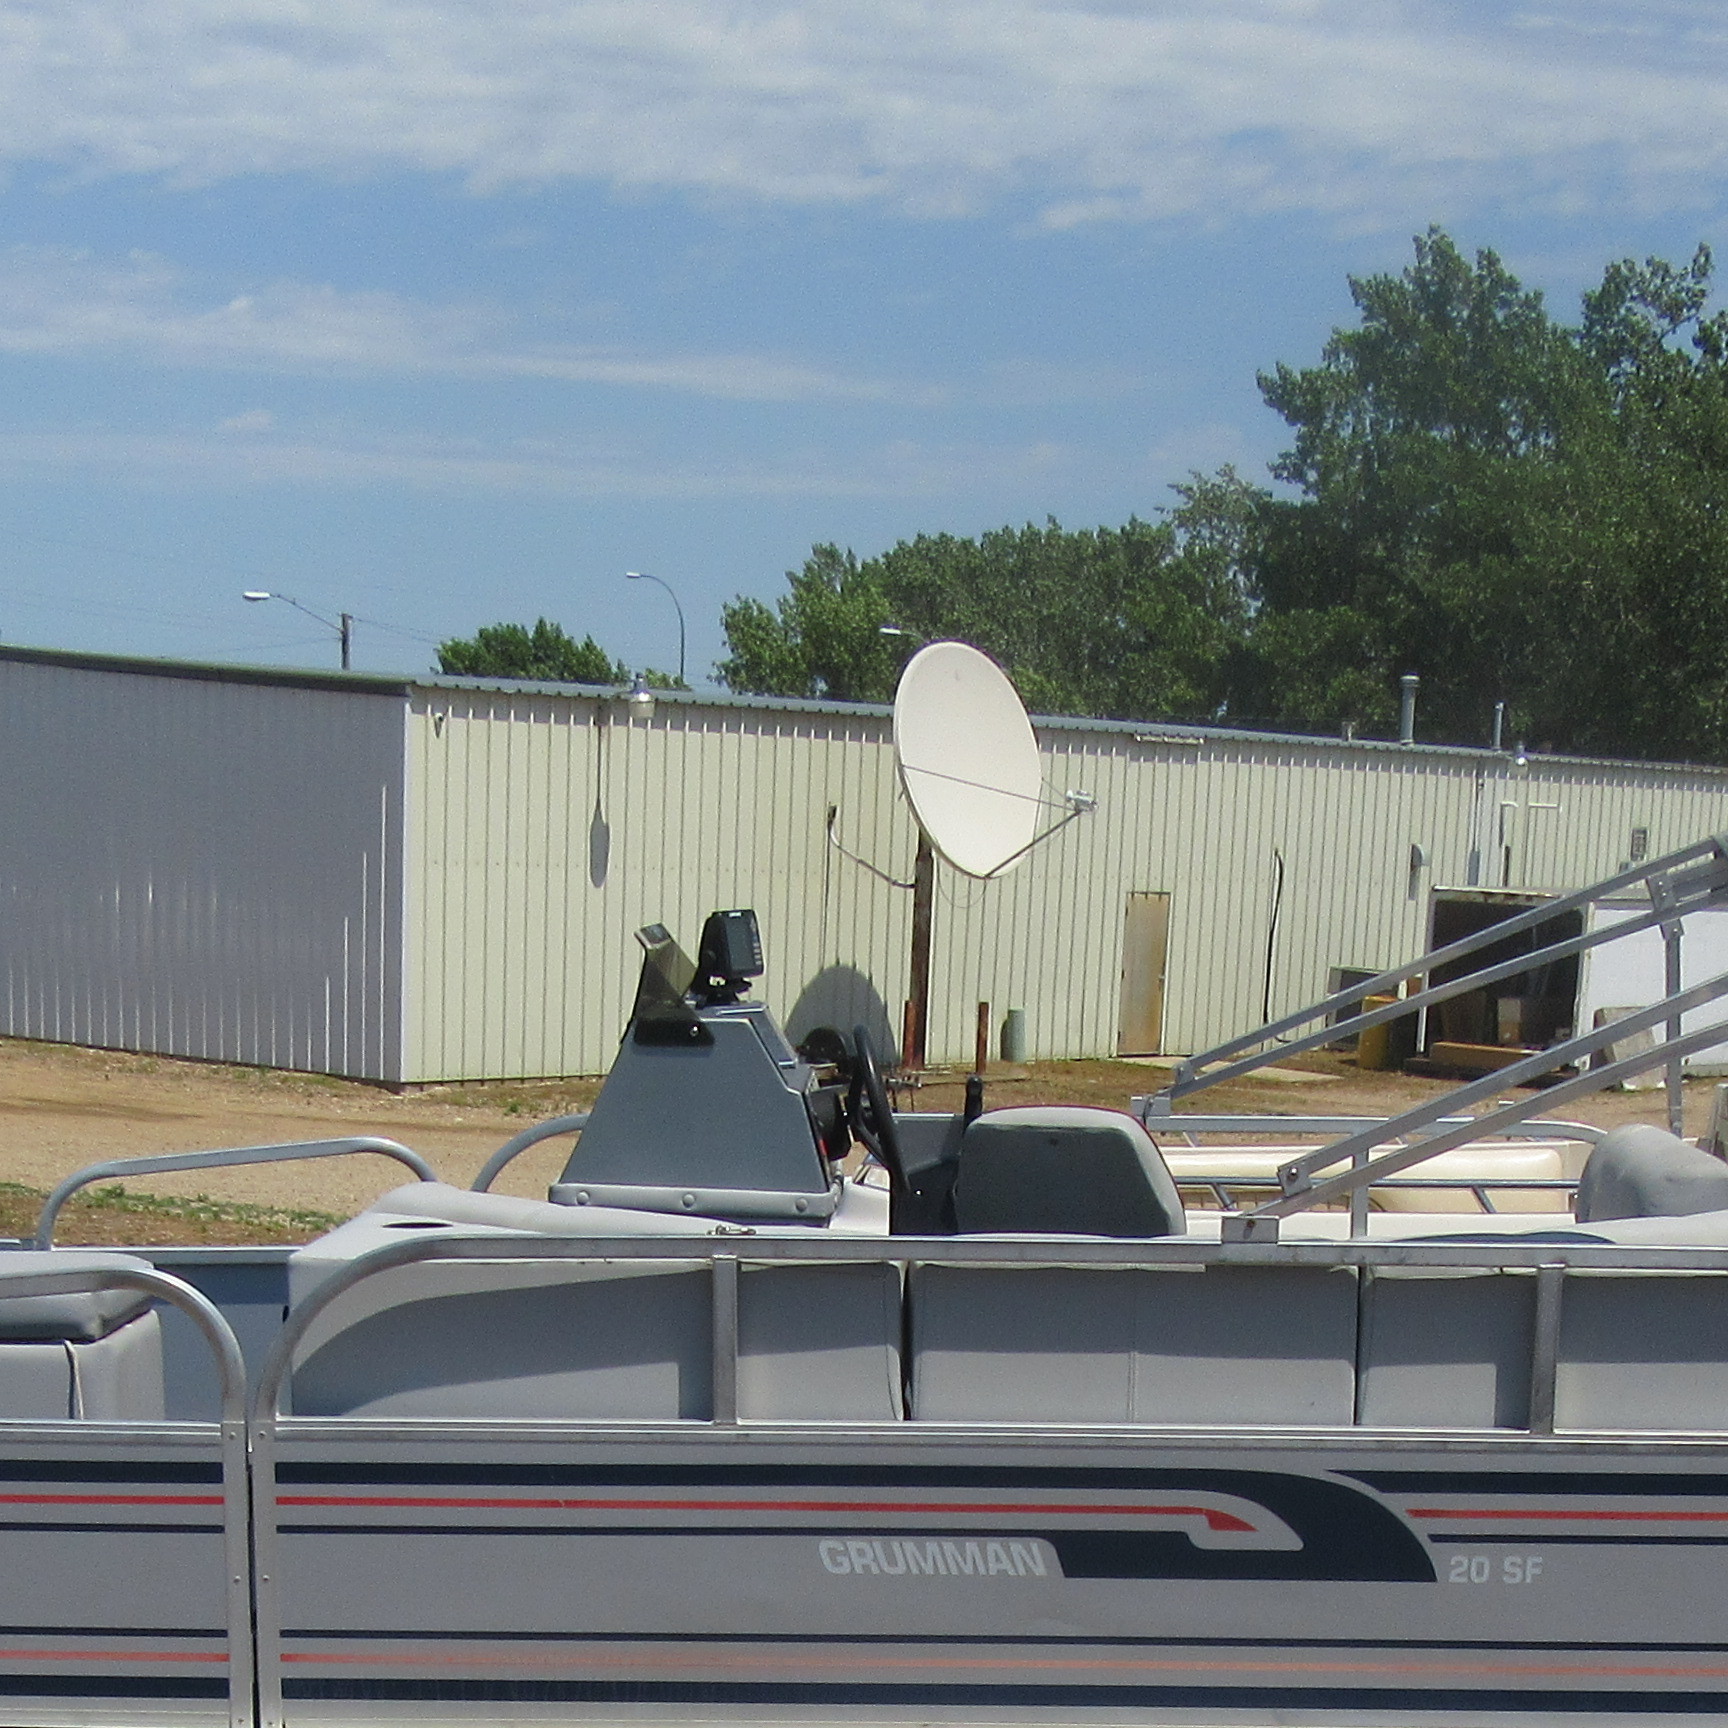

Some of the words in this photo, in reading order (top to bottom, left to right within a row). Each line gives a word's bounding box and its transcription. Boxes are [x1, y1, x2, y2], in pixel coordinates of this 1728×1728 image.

[817, 1538, 1048, 1578] GRUMMAN
[1448, 1554, 1491, 1585] 20
[1502, 1556, 1544, 1586] SF
